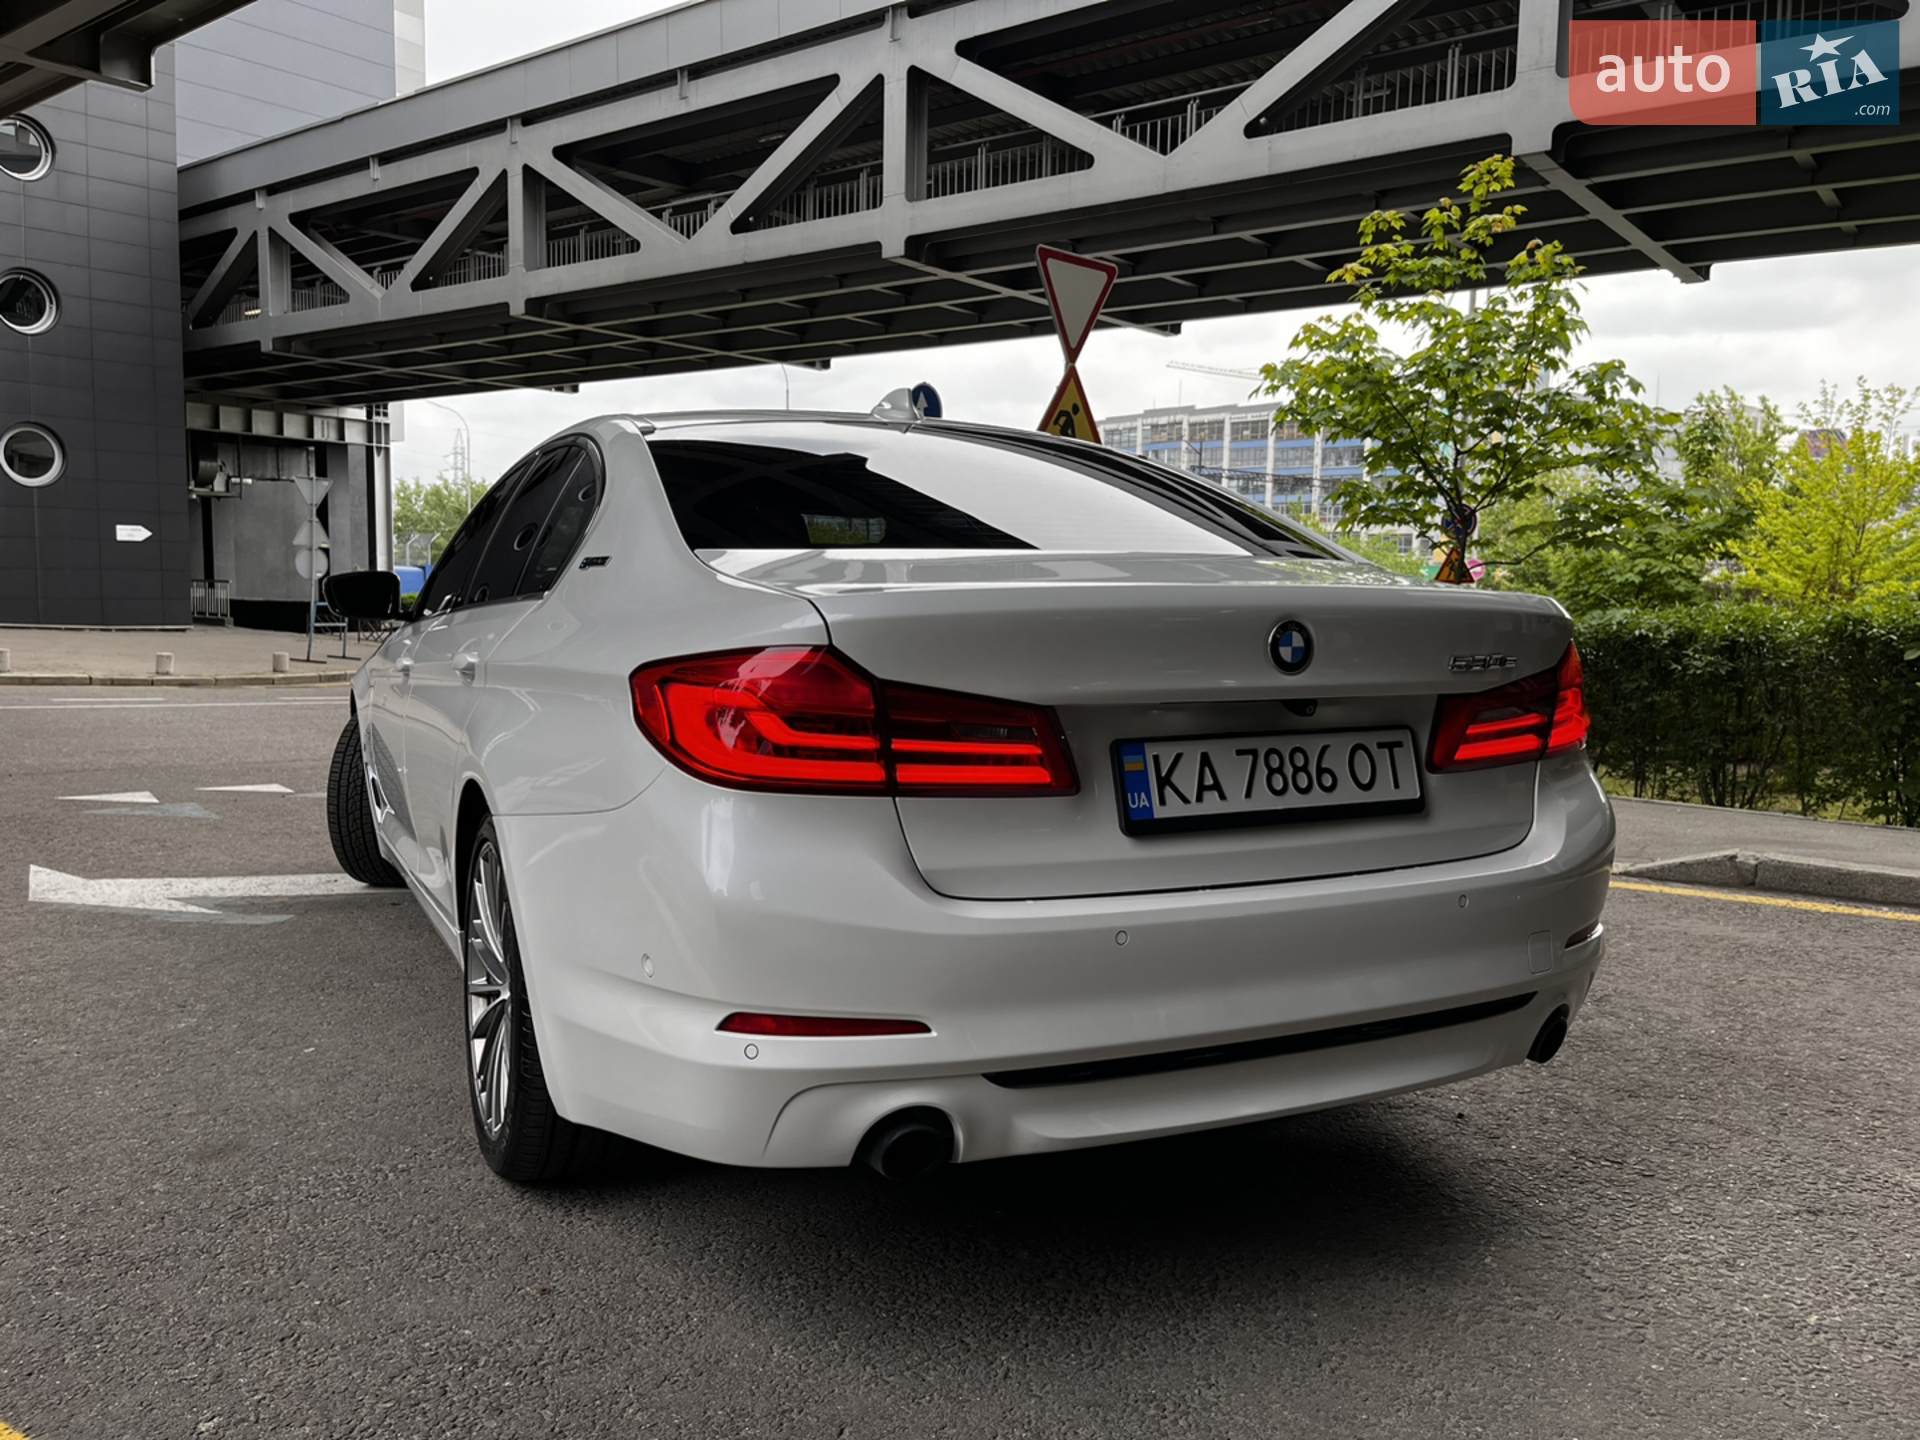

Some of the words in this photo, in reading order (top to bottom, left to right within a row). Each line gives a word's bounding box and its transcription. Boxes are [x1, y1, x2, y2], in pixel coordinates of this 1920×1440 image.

[1151, 751, 1229, 806] KA
[1235, 744, 1338, 799] 7886
[1347, 741, 1404, 792] OT
[1127, 791, 1150, 809] UA
